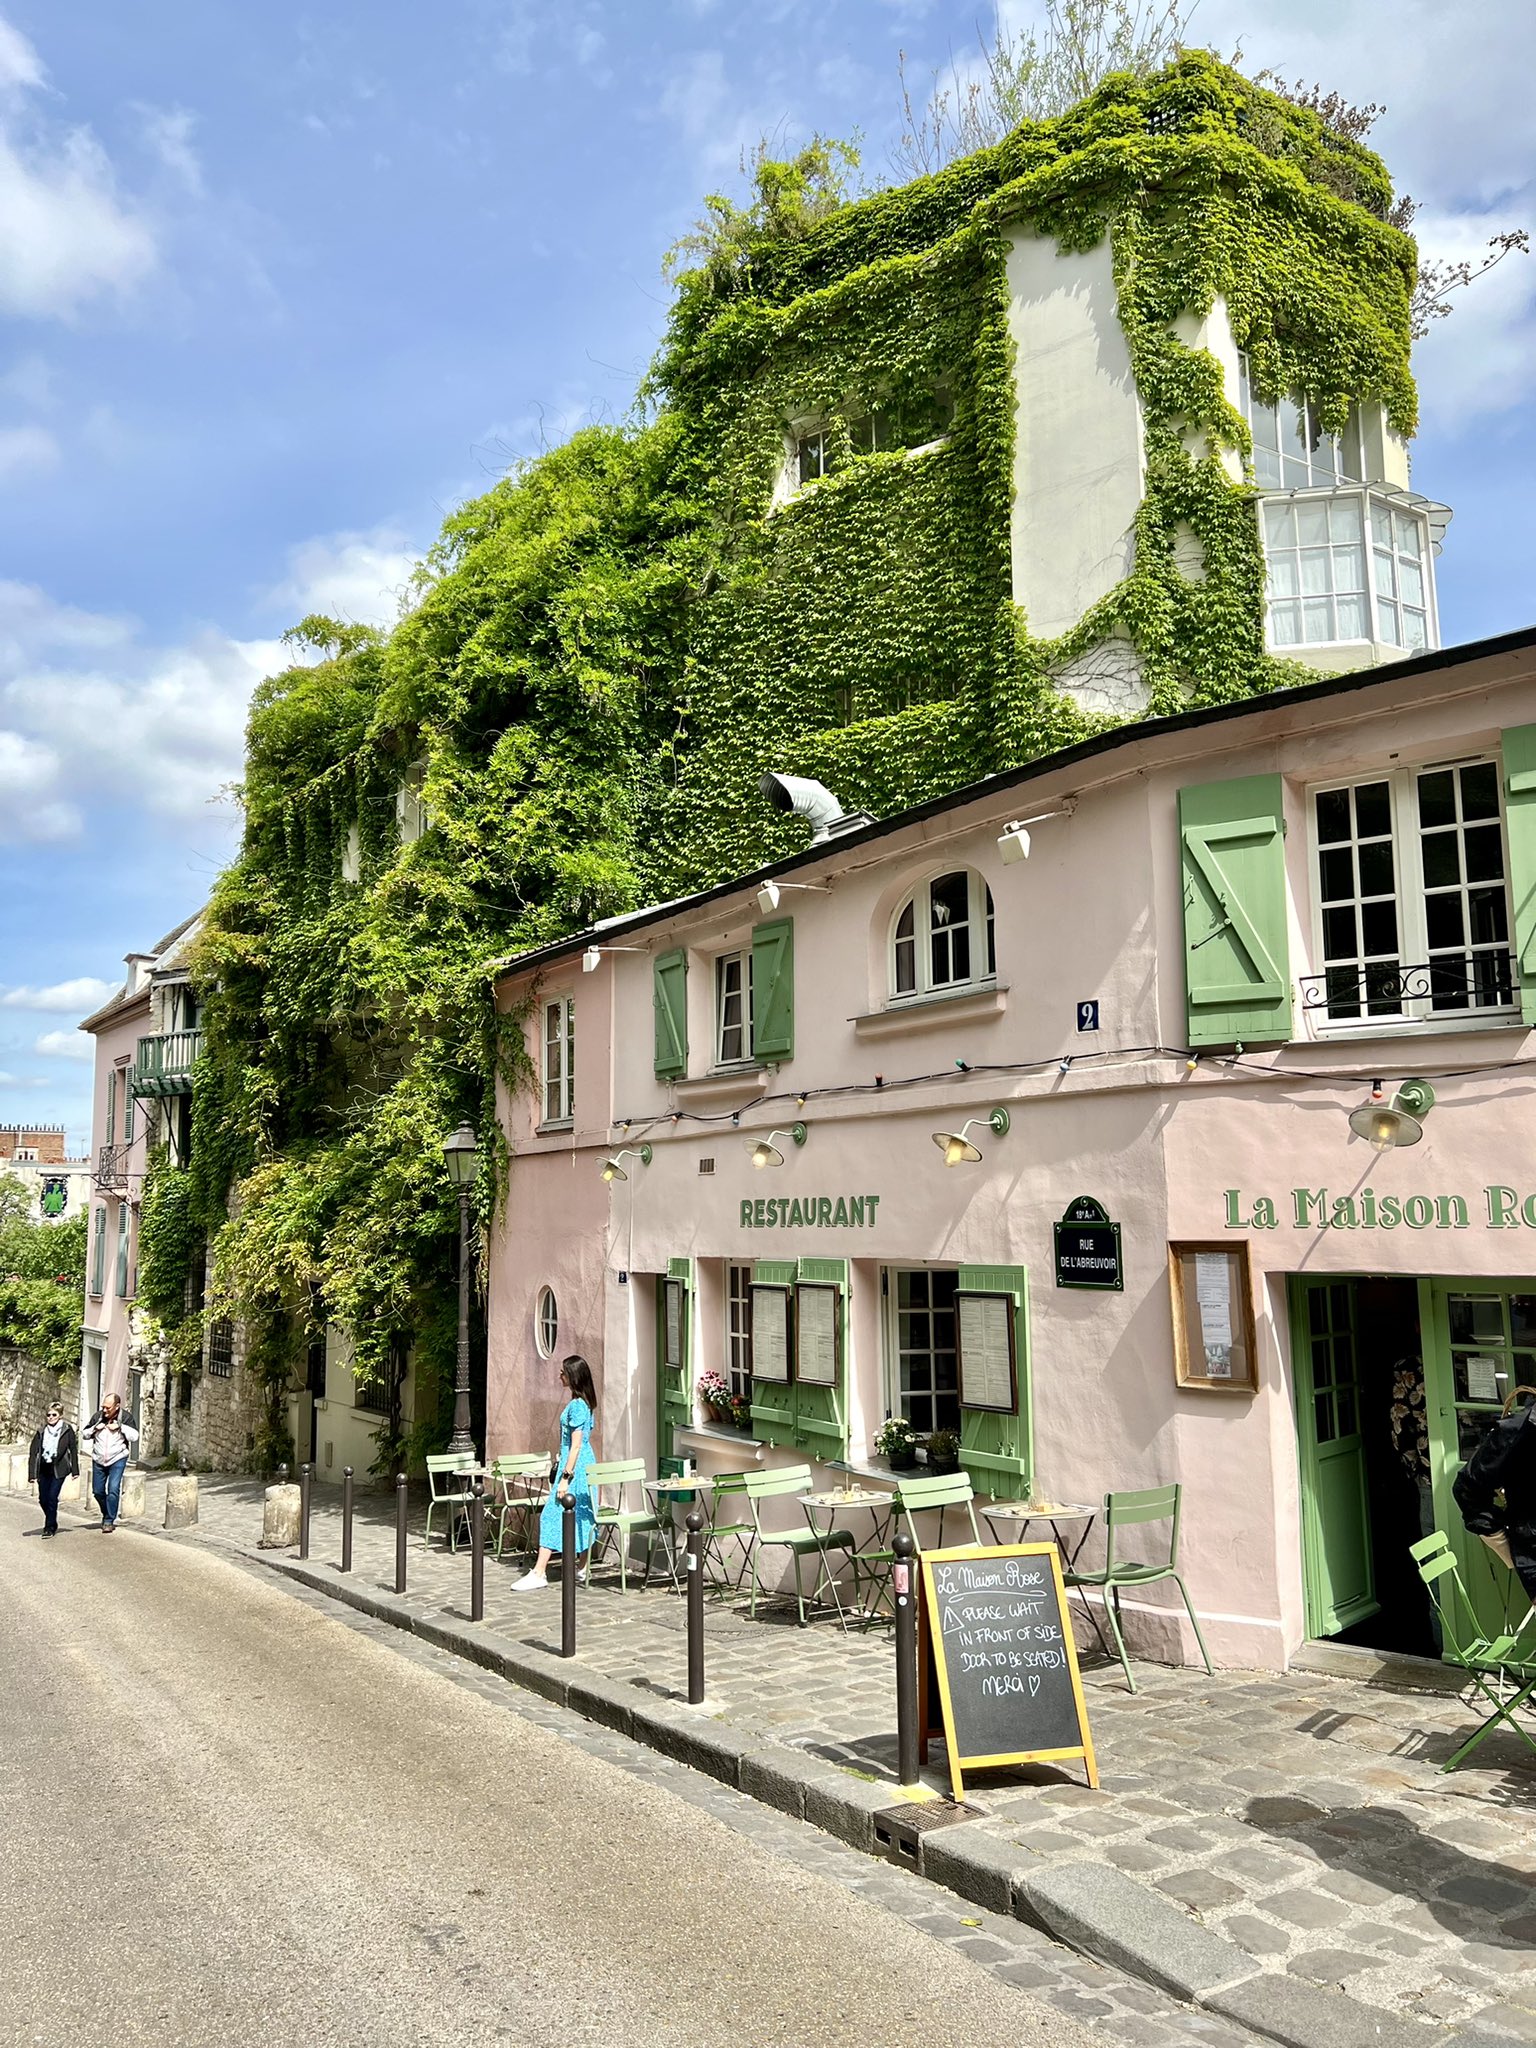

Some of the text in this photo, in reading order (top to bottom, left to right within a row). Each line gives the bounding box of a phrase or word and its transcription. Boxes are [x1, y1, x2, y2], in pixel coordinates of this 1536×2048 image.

[1081, 1003, 1094, 1030] 2
[740, 1195, 880, 1228] RESTAURANT
[1223, 1189, 1279, 1229] La
[1291, 1187, 1470, 1229] Maison
[1079, 1239, 1094, 1250] RUE
[1060, 1256, 1117, 1269] DE L'ABREUVOIR
[937, 1561, 1044, 1594] La Maison Rose
[961, 1605, 1006, 1621] PLEASE
[974, 1627, 1014, 1643] FRONT
[1016, 1625, 1032, 1640] OF
[960, 1651, 992, 1672] DOOR
[991, 1652, 1007, 1666] TO
[1008, 1650, 1023, 1668] BE
